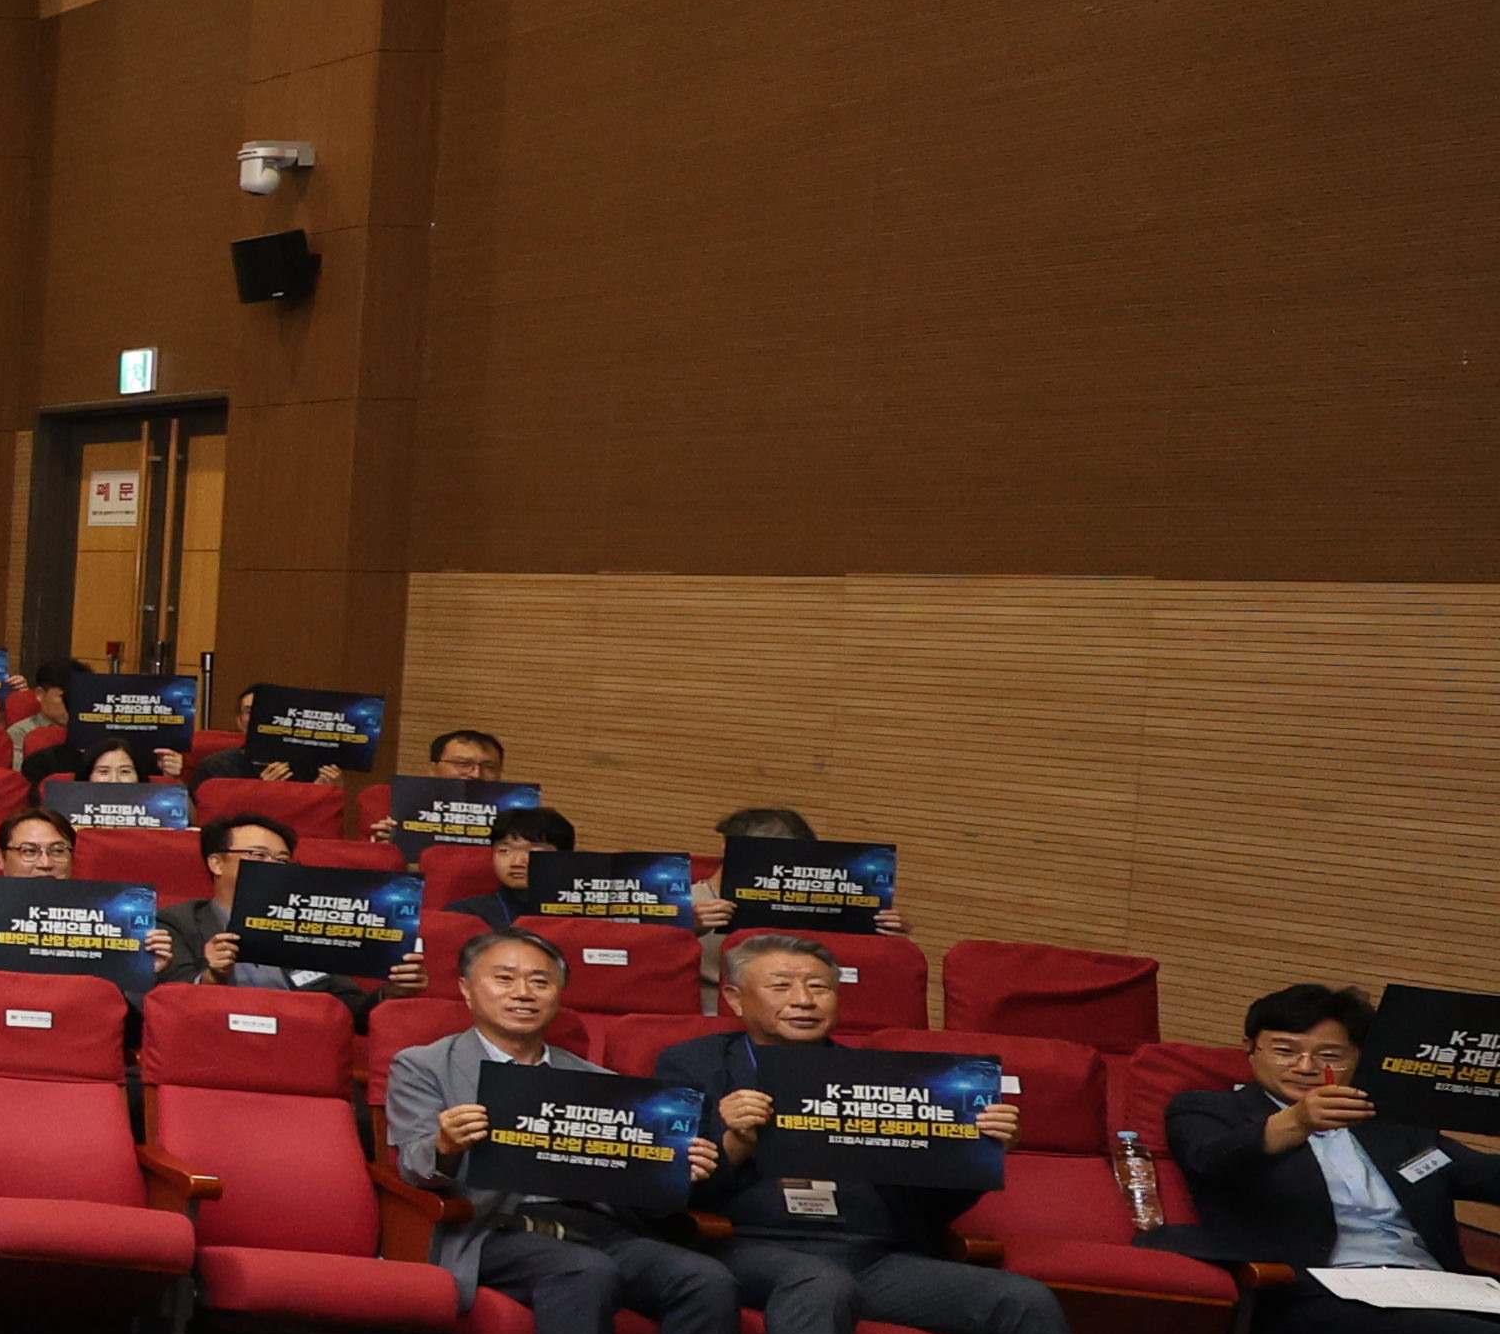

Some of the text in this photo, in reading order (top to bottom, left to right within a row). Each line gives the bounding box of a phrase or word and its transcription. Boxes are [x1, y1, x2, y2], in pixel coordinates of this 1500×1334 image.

[827, 1084, 929, 1103] K-피지컬AI
[802, 1099, 954, 1122] 기술 자립으로 여는
[777, 1115, 841, 1131] 대한민국
[844, 1118, 875, 1133] 산업
